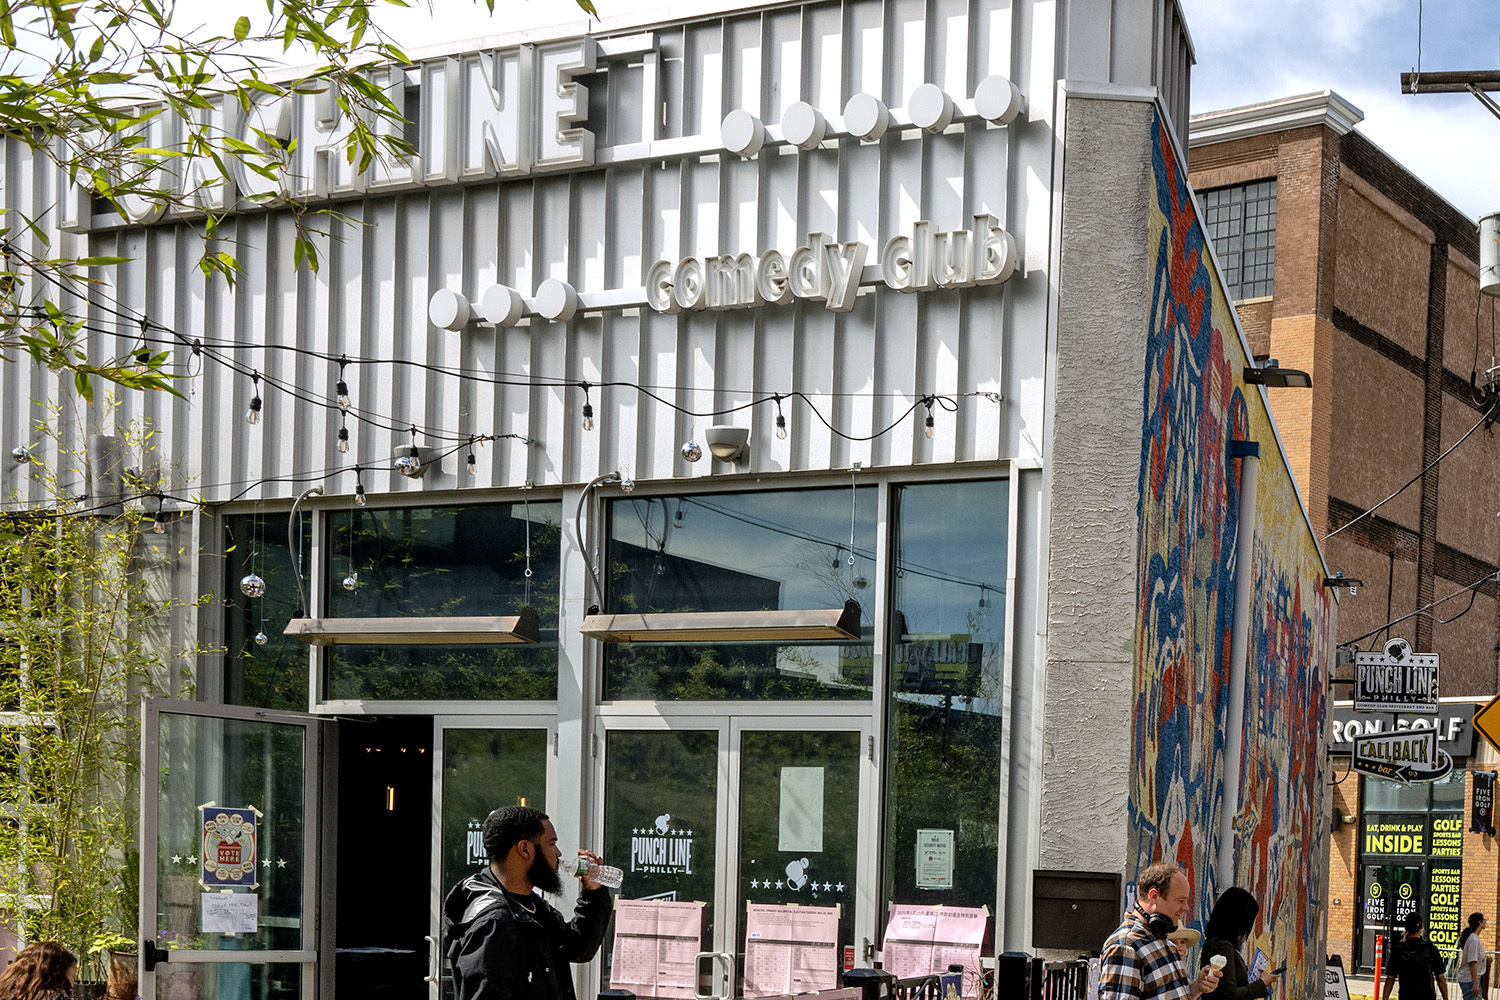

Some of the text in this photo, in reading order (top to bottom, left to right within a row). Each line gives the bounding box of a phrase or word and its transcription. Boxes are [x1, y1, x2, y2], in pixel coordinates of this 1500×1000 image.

[646, 213, 1017, 314] comedy club
[1357, 666, 1437, 703] PUNCH LINE
[1360, 736, 1430, 764] CALLBACK
[1377, 764, 1393, 775] bar
[1475, 787, 1491, 795] FIVE
[1366, 824, 1423, 833] EAT, DRINK & PLAY
[1433, 819, 1463, 831] GOLF
[1365, 835, 1424, 853] INSIDE
[1432, 838, 1462, 847] LESSONS
[631, 837, 693, 875] PUNCH LINE
[1432, 847, 1461, 856] PARTIES
[1431, 875, 1460, 883] LESSONS
[1431, 884, 1460, 893] PARTIES
[1367, 898, 1385, 907] FIVE
[1396, 899, 1416, 908] FIVE
[1431, 893, 1460, 905] GOLF
[1429, 913, 1459, 921] LESSONS
[1429, 921, 1458, 930] PARTIES
[1429, 931, 1458, 943] GOLF
